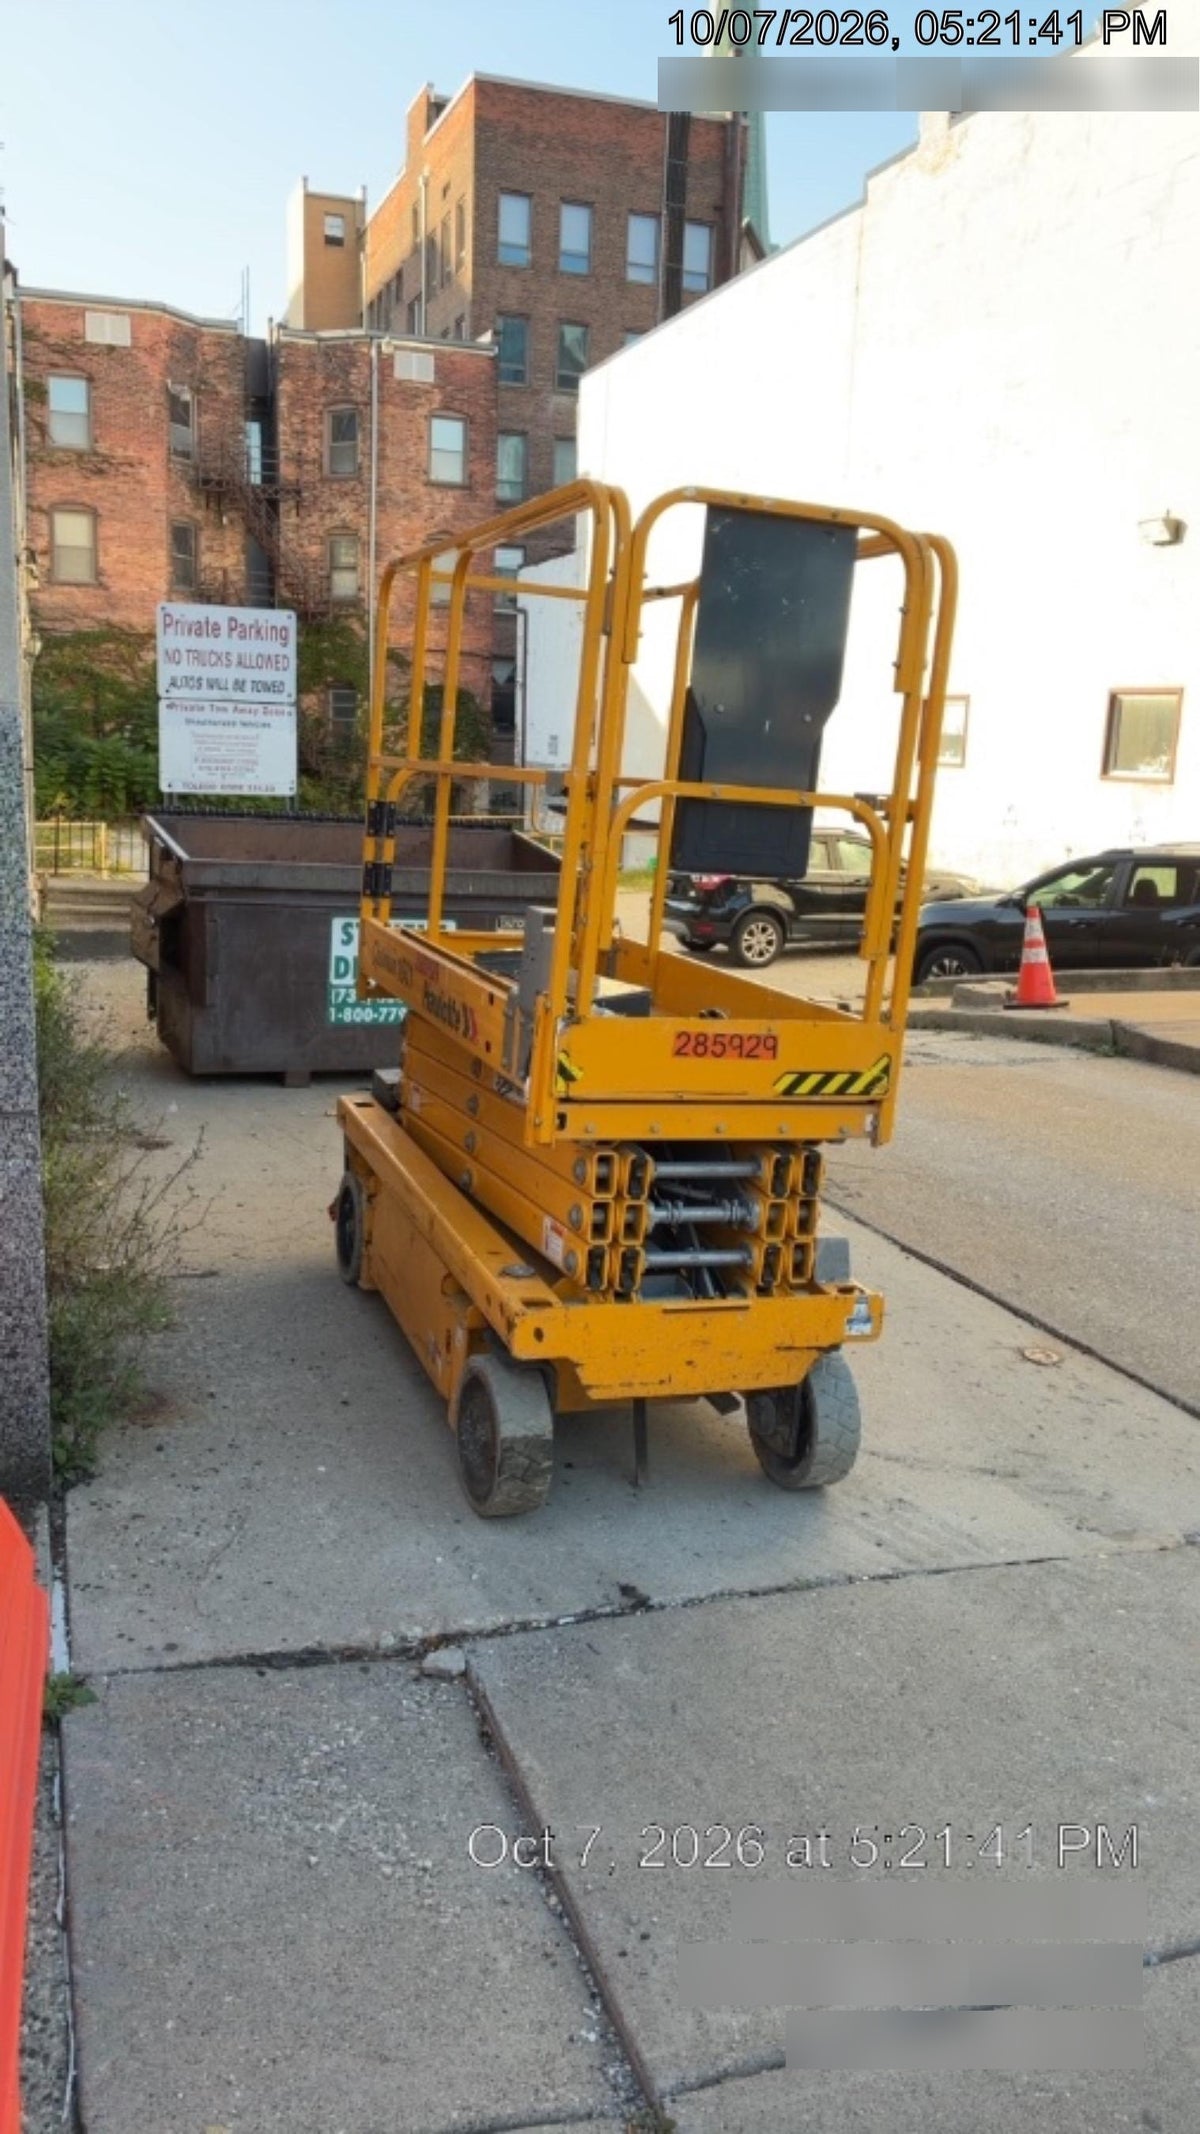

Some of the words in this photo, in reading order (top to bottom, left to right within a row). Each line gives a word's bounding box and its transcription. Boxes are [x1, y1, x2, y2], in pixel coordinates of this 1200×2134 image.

[163, 612, 221, 638] Private
[227, 617, 288, 646] Parking
[164, 649, 181, 665] NO
[185, 650, 232, 668] TRUCKS
[235, 652, 289, 671] ALLOWED
[168, 676, 203, 690] AUTOS
[206, 678, 228, 691] WILL
[232, 679, 247, 693] BE
[251, 680, 285, 693] TOWED
[673, 1031, 778, 1060] 285929
